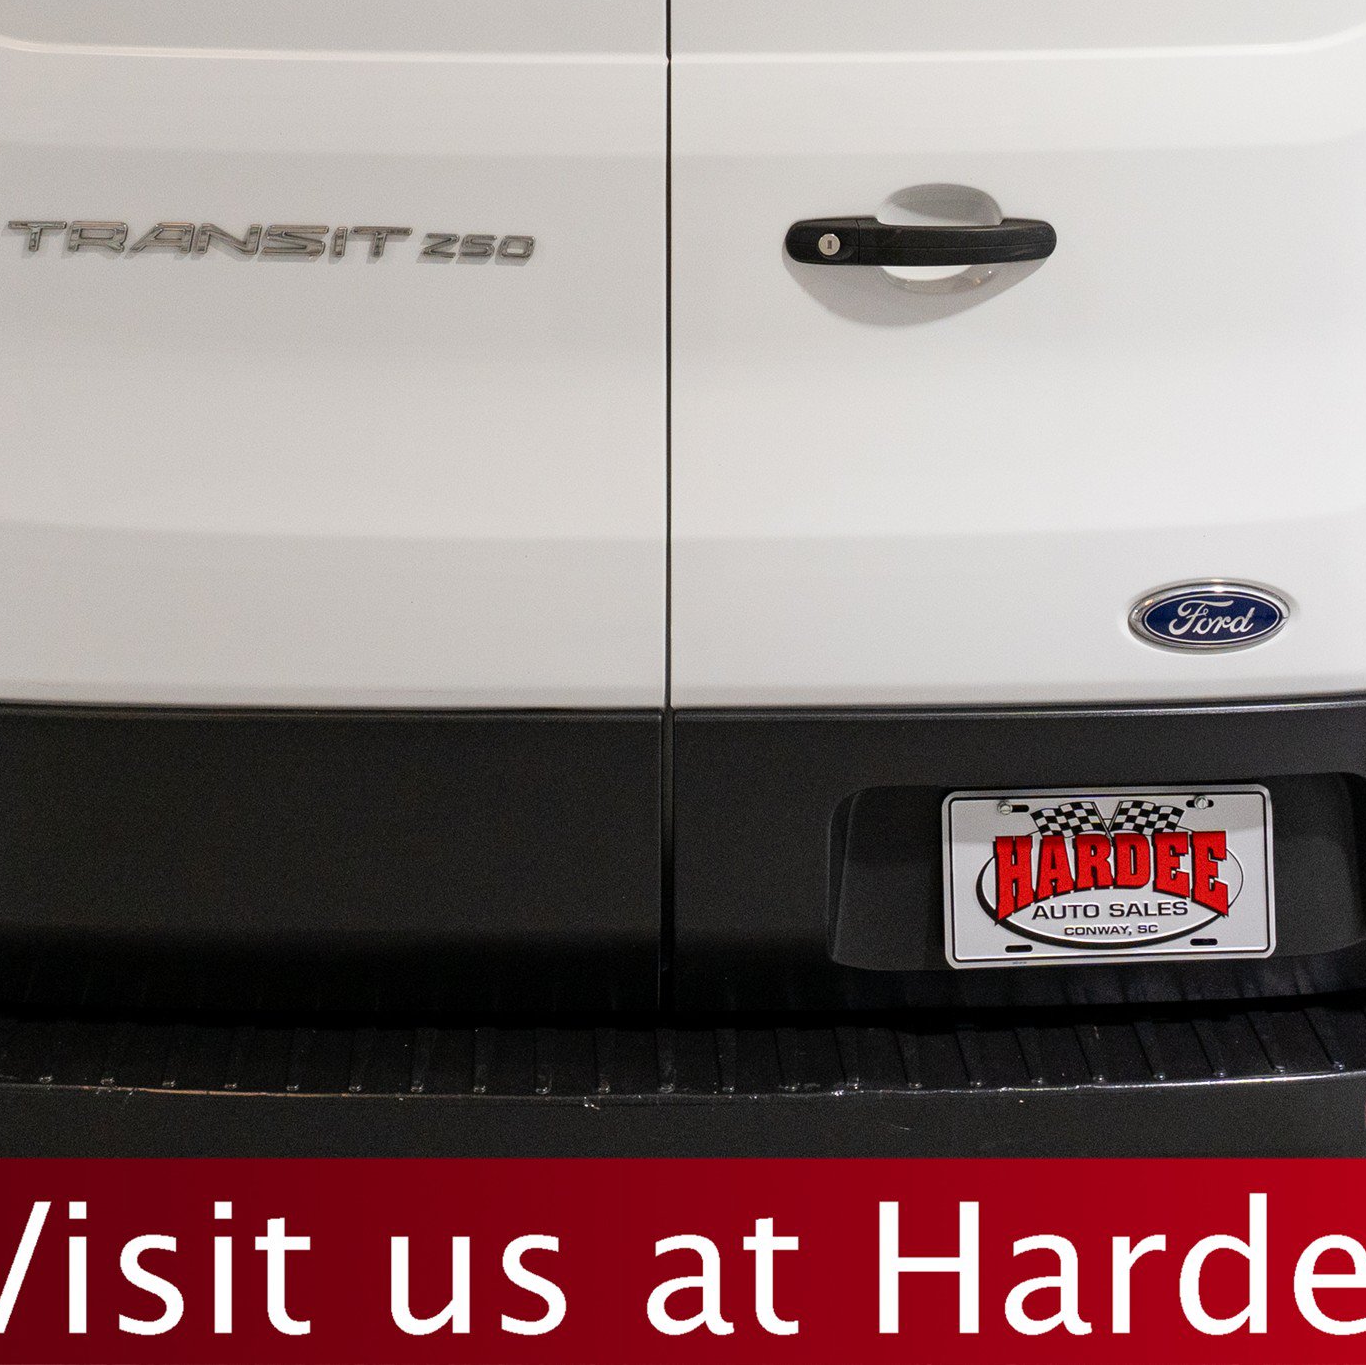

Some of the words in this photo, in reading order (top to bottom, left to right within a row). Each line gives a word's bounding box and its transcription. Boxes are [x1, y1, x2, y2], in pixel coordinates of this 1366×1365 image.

[7, 220, 414, 259] TRANSIT
[422, 233, 536, 260] 250
[1168, 599, 1256, 636] Ford
[993, 830, 1230, 922] HARDEE
[1032, 903, 1100, 921] AUTO
[1109, 900, 1189, 918] SALES
[1064, 924, 1133, 936] CONWAY,
[1137, 923, 1159, 934] SC
